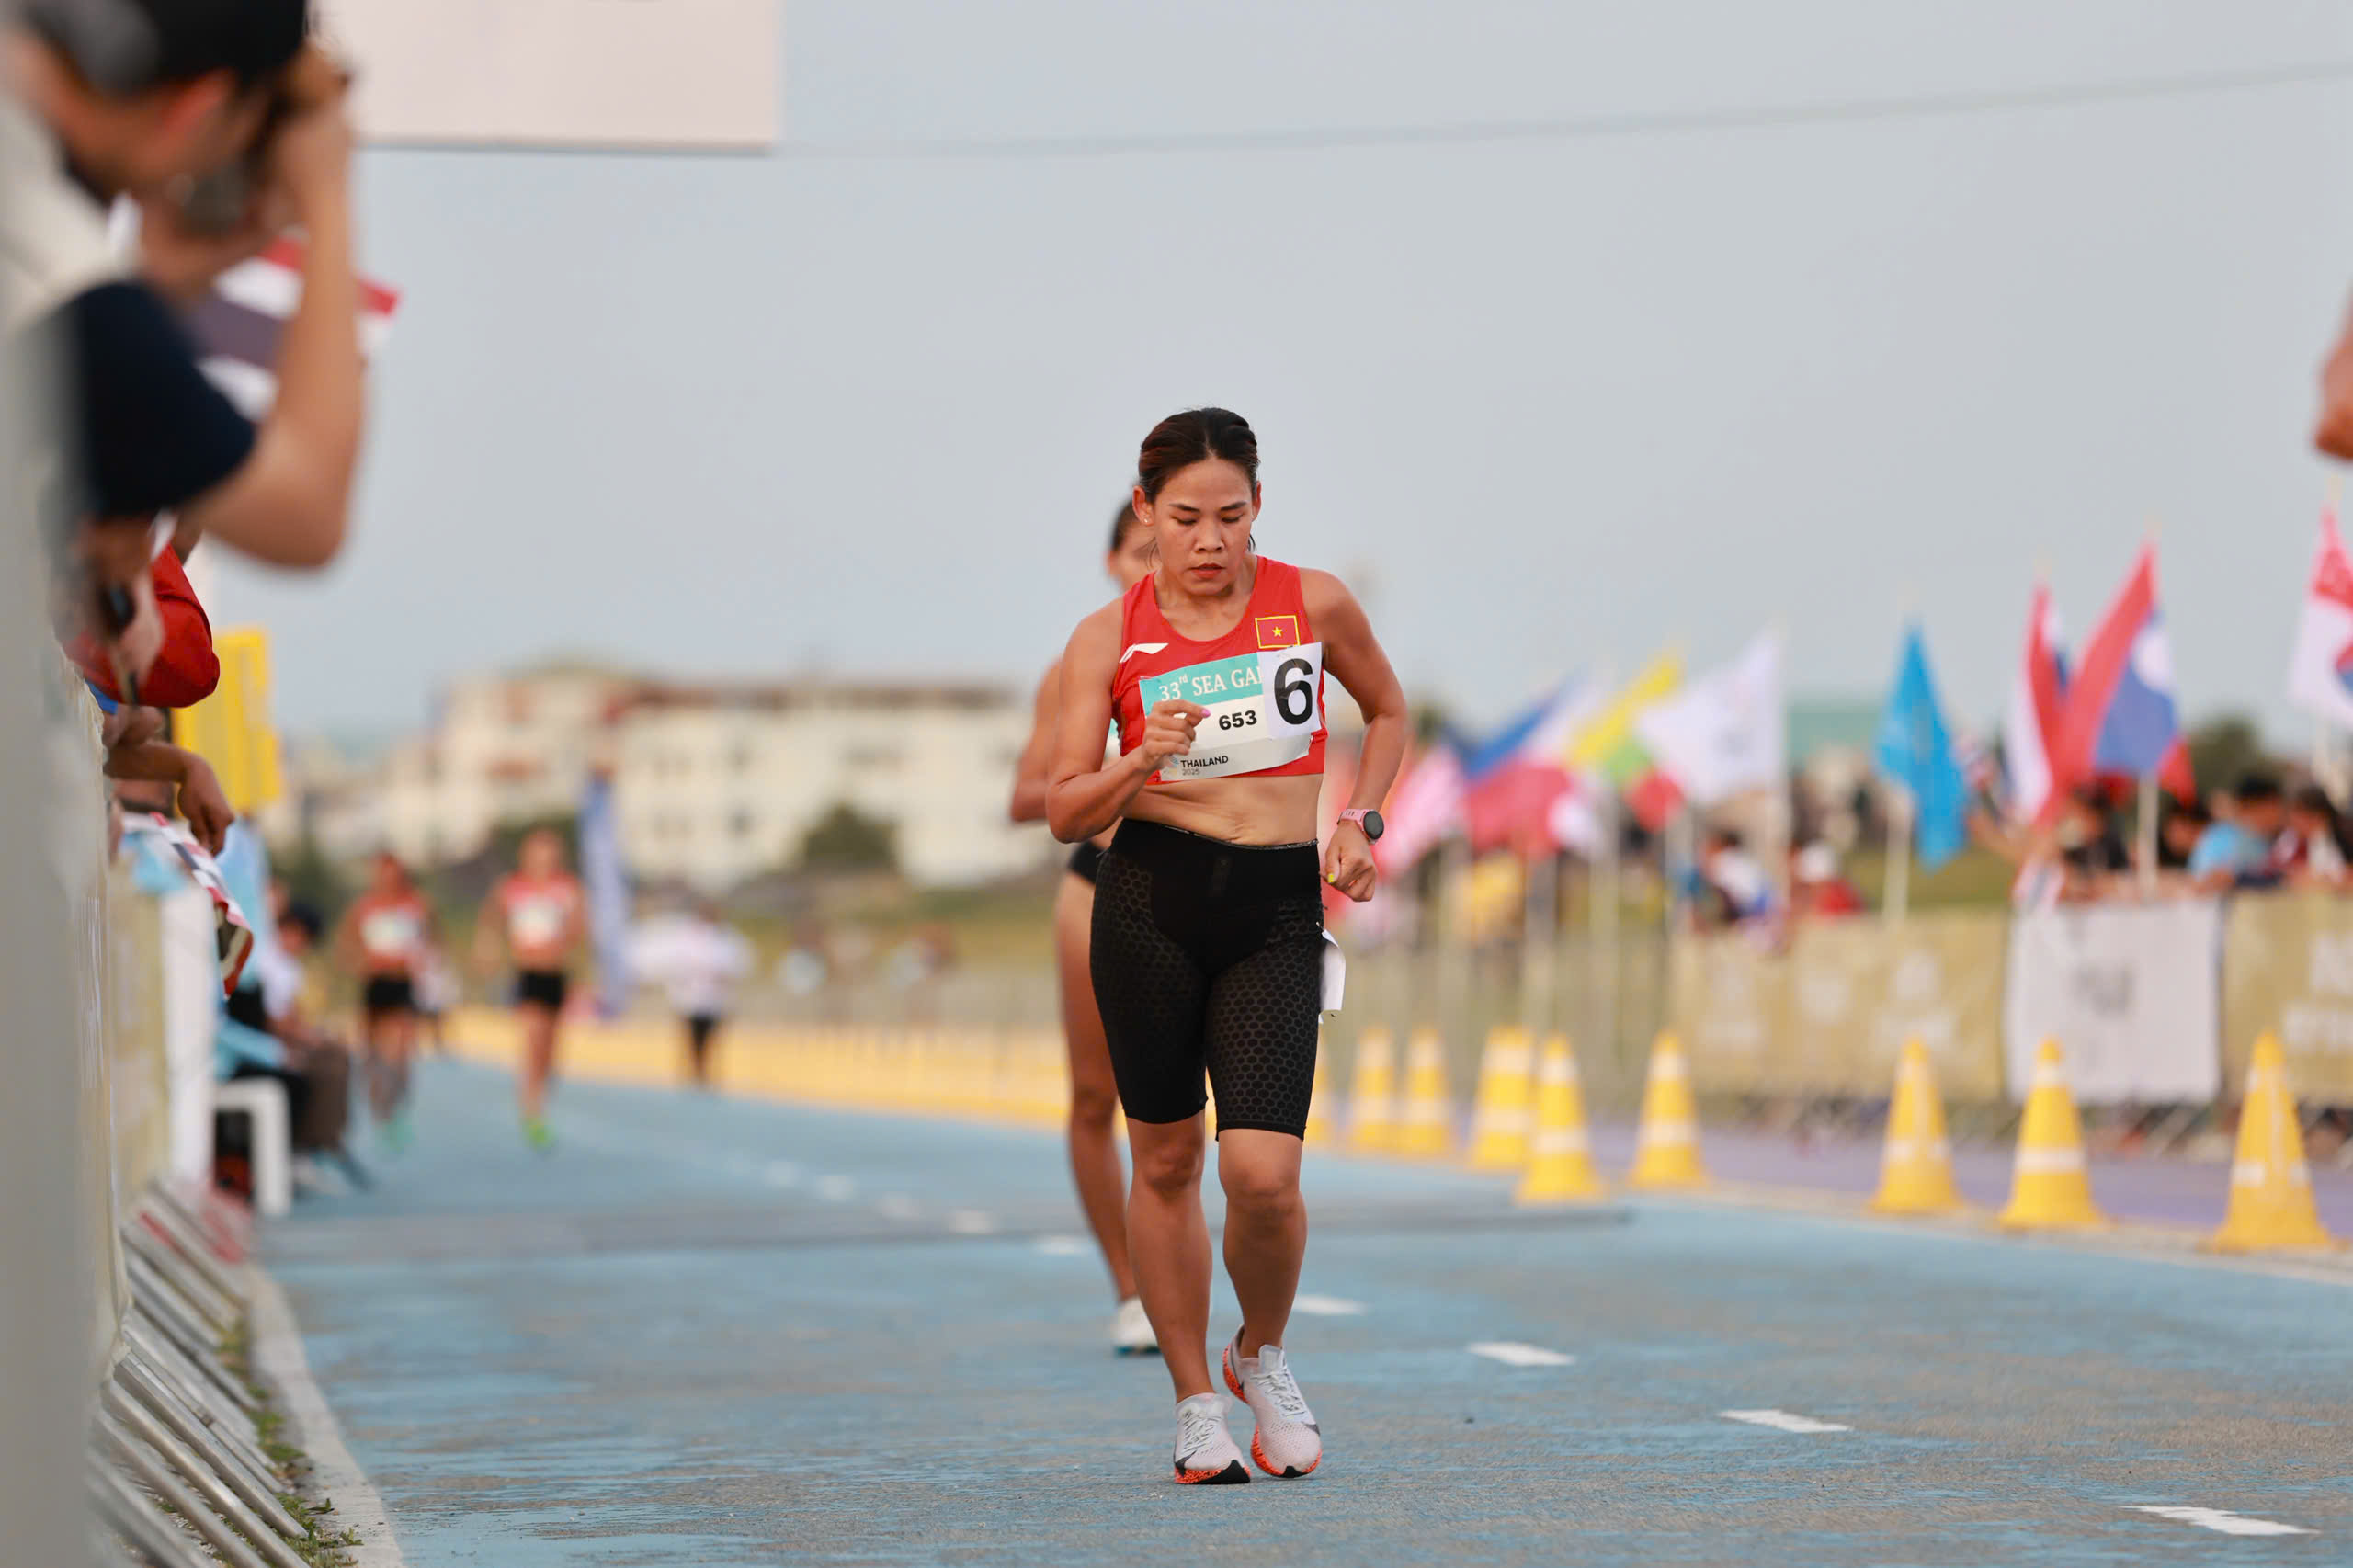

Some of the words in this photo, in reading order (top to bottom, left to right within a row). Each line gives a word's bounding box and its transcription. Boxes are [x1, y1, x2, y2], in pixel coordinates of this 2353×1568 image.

[1159, 674, 1188, 701] 33rd
[1191, 673, 1228, 696] SEA
[1274, 658, 1313, 725] 6
[1218, 710, 1257, 731] 653
[1180, 756, 1229, 768] THAILAND
